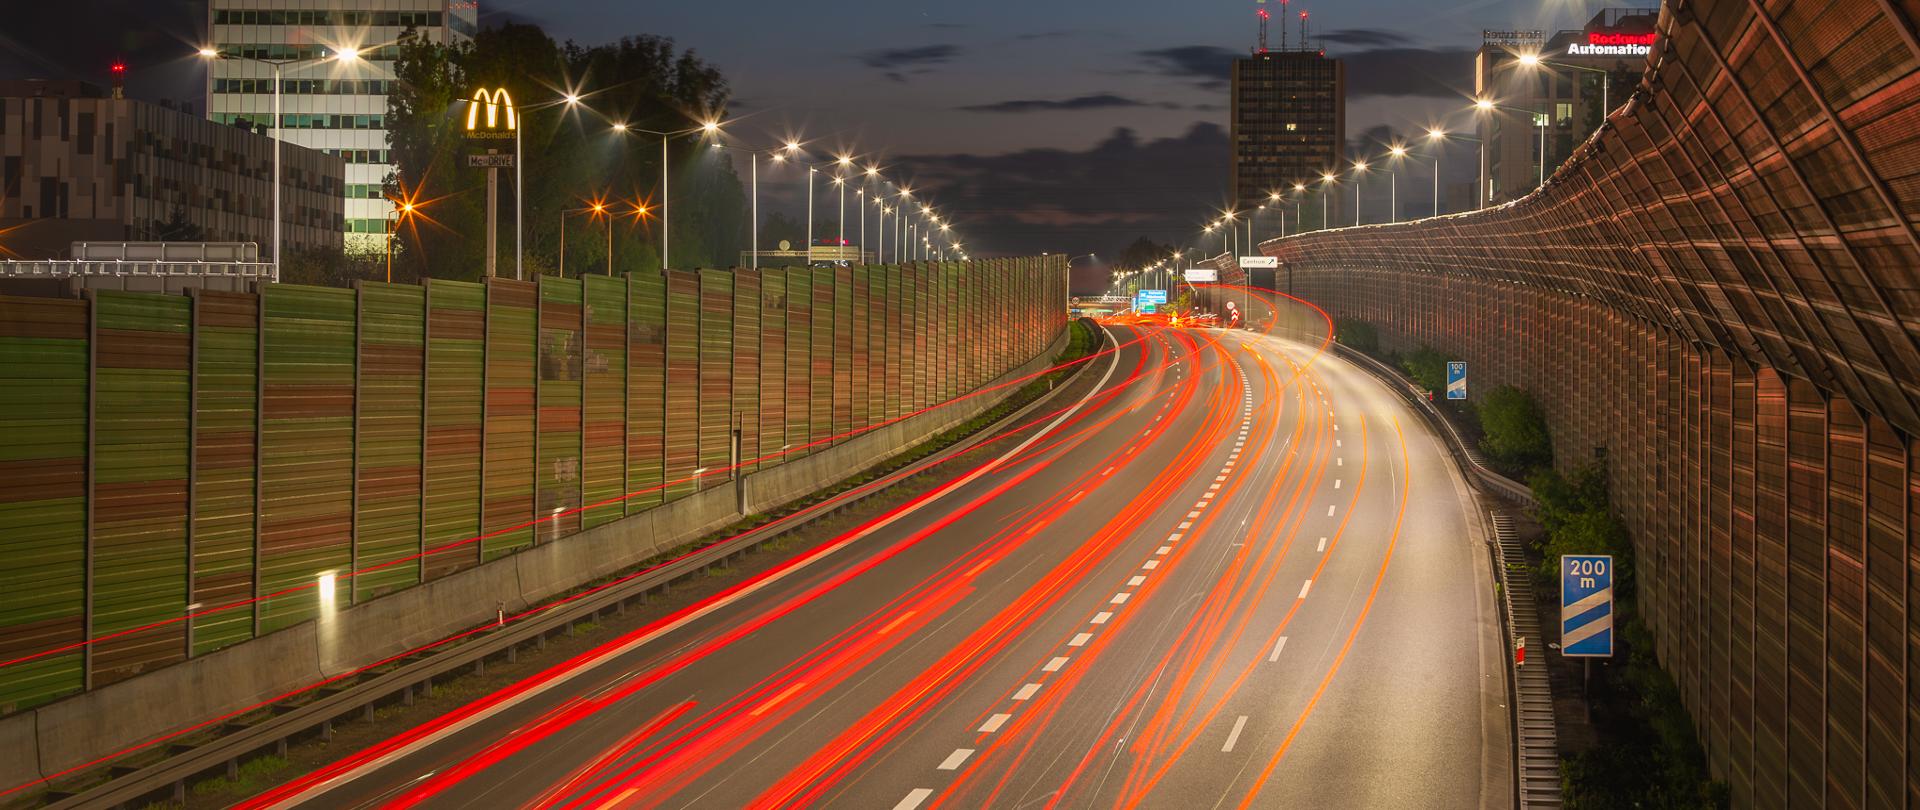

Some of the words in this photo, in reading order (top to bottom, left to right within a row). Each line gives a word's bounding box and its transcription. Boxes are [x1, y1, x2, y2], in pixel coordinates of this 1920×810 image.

[1589, 32, 1656, 44] Rockwell
[1570, 560, 1605, 575] 200
[1580, 577, 1595, 588] m
